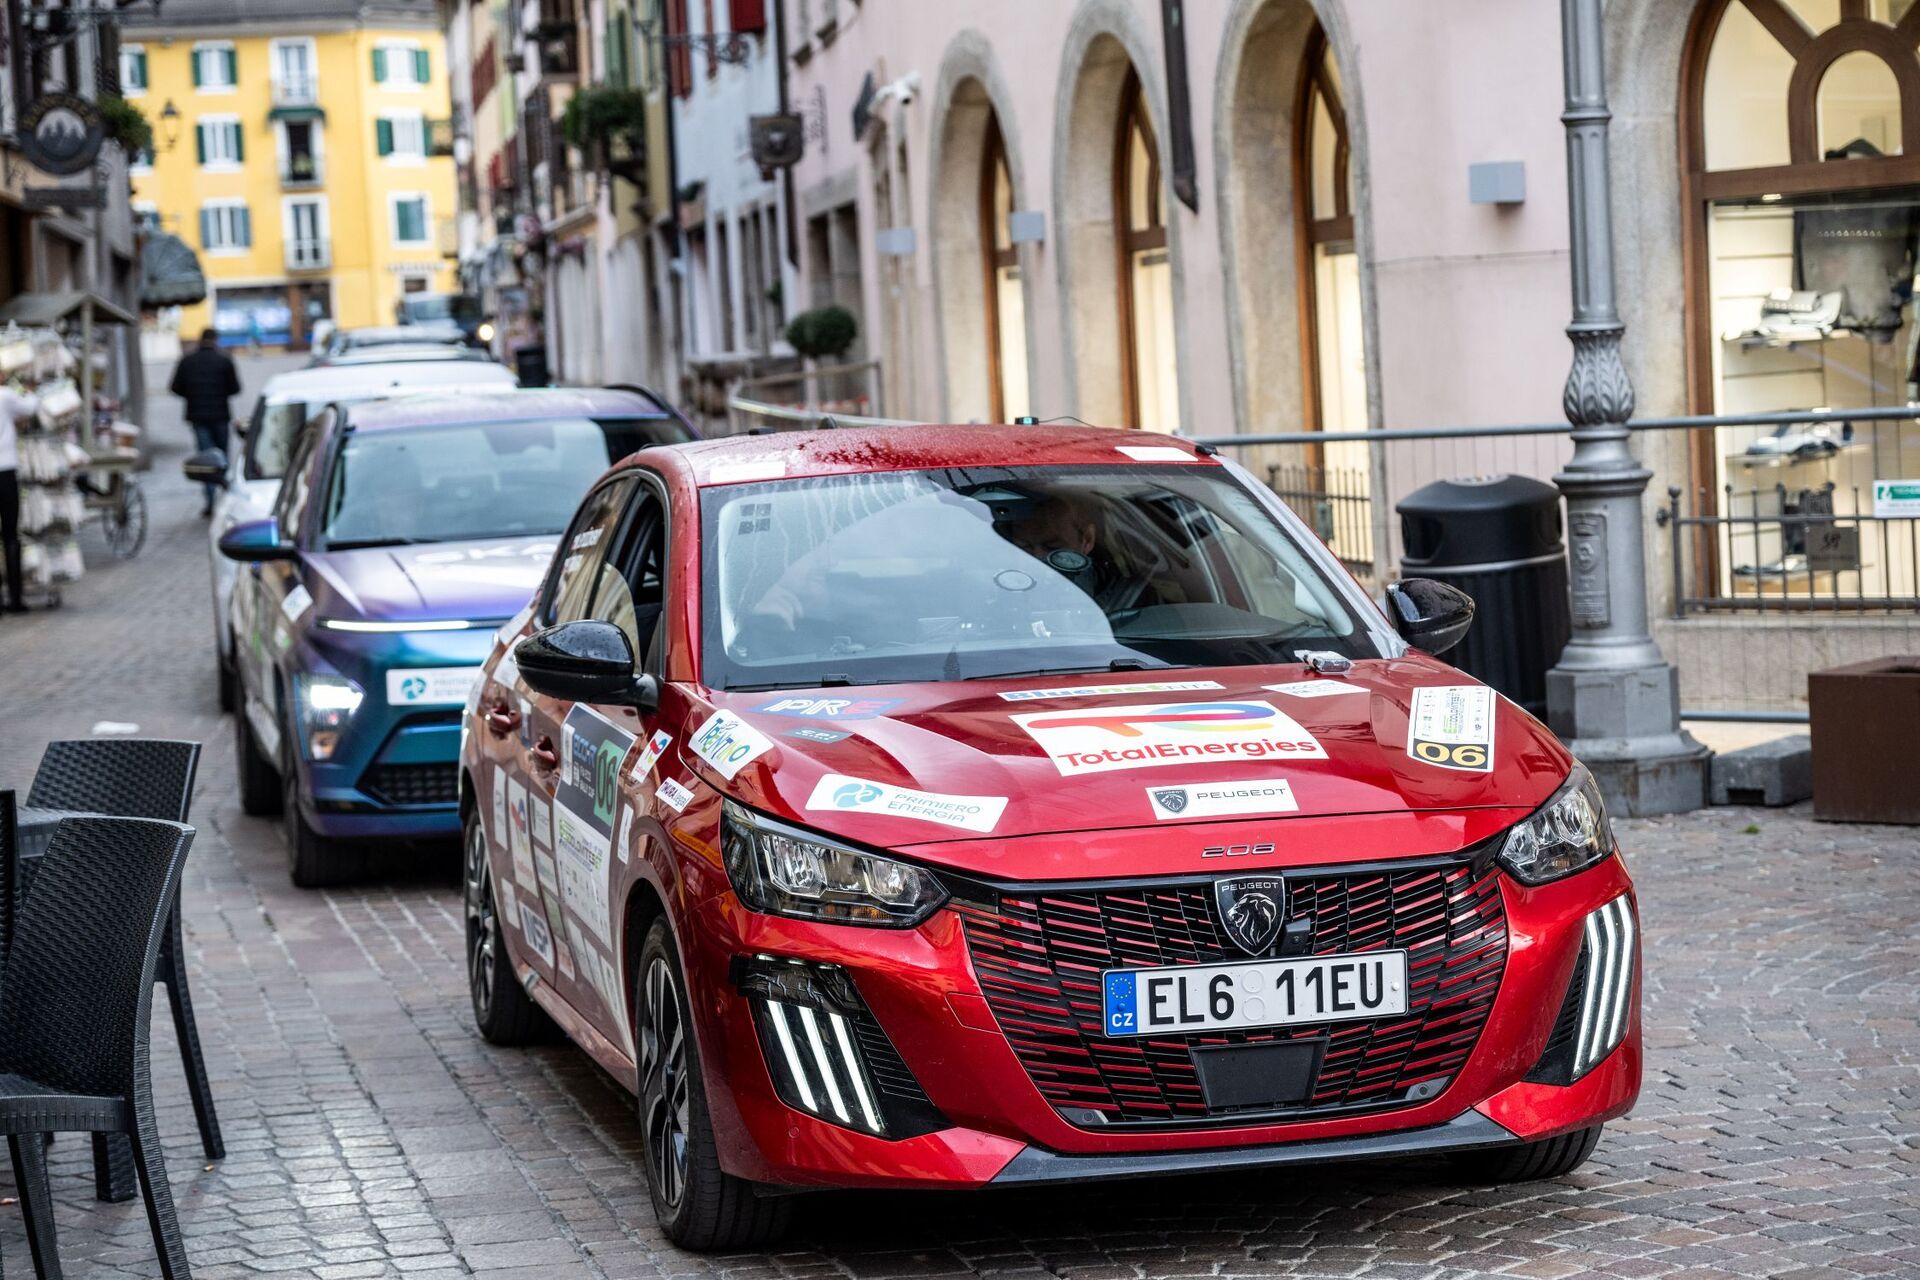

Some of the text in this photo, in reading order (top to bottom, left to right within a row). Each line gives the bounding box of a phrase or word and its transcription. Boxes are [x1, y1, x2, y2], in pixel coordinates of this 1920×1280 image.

[763, 699, 891, 716] PRE
[698, 717, 751, 763] TRENTINO
[1057, 738, 1318, 768] TotalEnergies
[1416, 742, 1486, 767] 06
[596, 749, 617, 816] 06
[894, 793, 981, 814] PRIMIERO
[1197, 788, 1286, 800] PEUGEOT
[888, 800, 966, 823] ENERGIA
[1201, 843, 1276, 859] 208
[1221, 881, 1279, 892] PEUGEOT
[1149, 960, 1384, 1026] EL6 11EU
[1111, 1012, 1134, 1028] CZ
